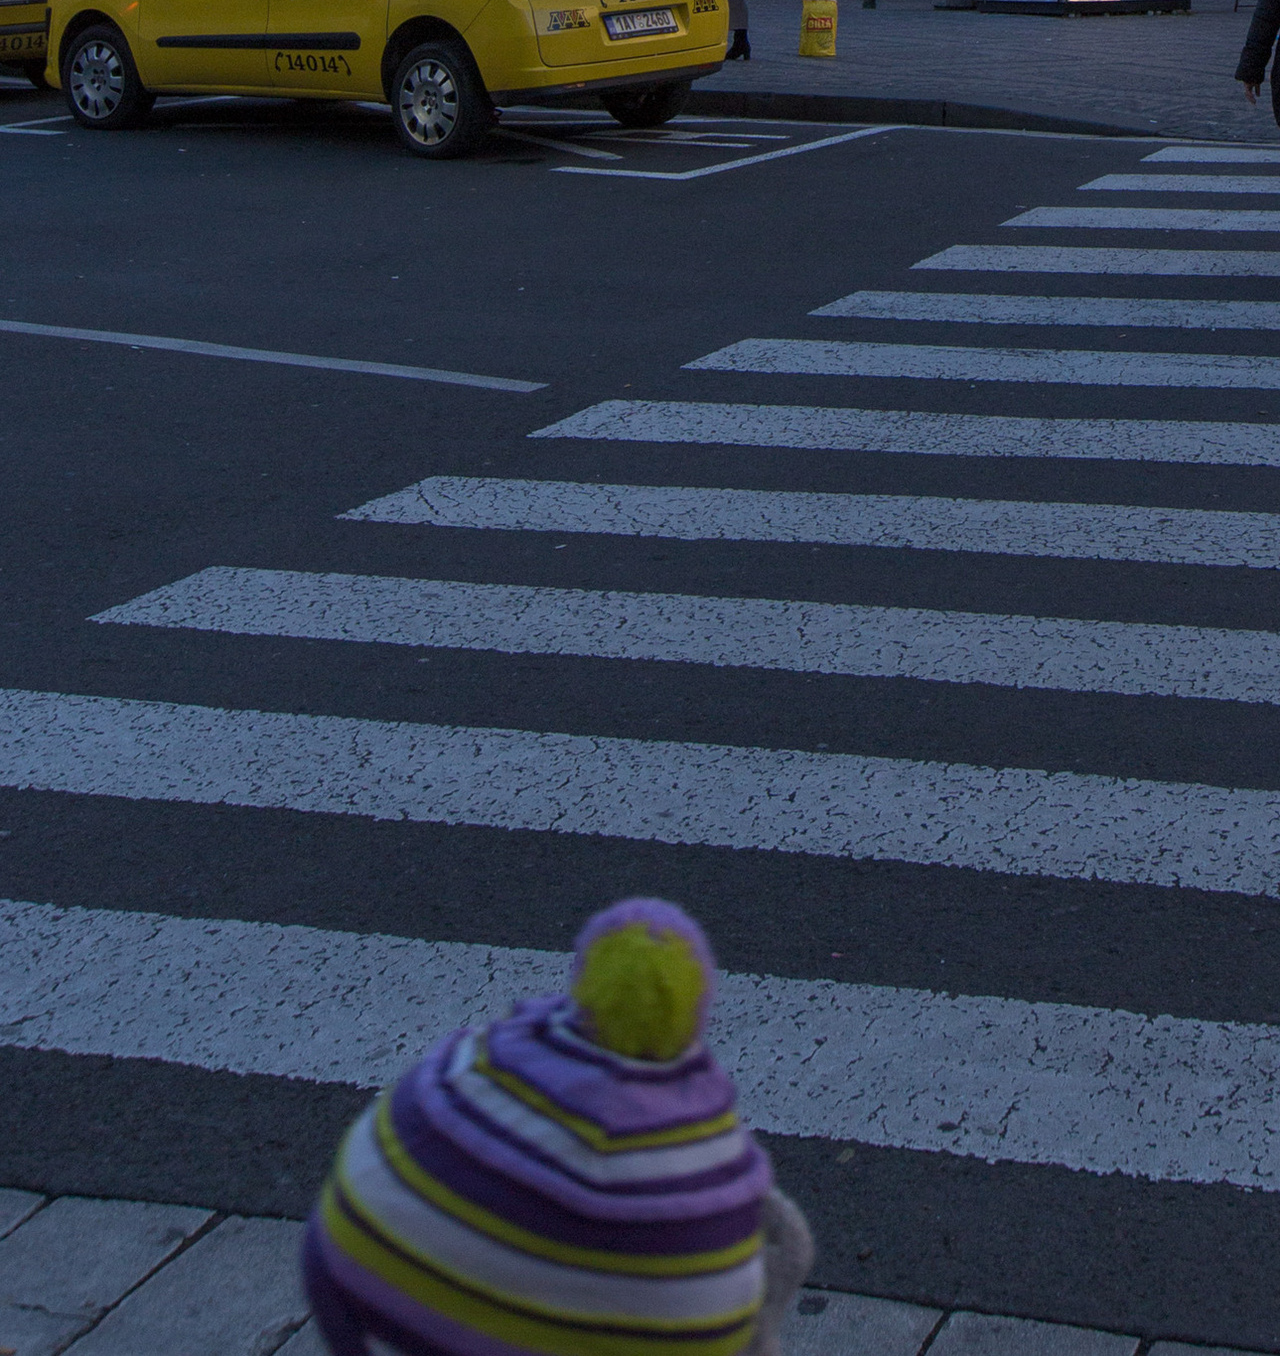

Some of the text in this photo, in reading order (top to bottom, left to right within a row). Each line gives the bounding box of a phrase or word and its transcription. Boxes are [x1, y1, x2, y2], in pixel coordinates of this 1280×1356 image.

[548, 9, 590, 31] AAA
[616, 11, 671, 31] 1AY 2460
